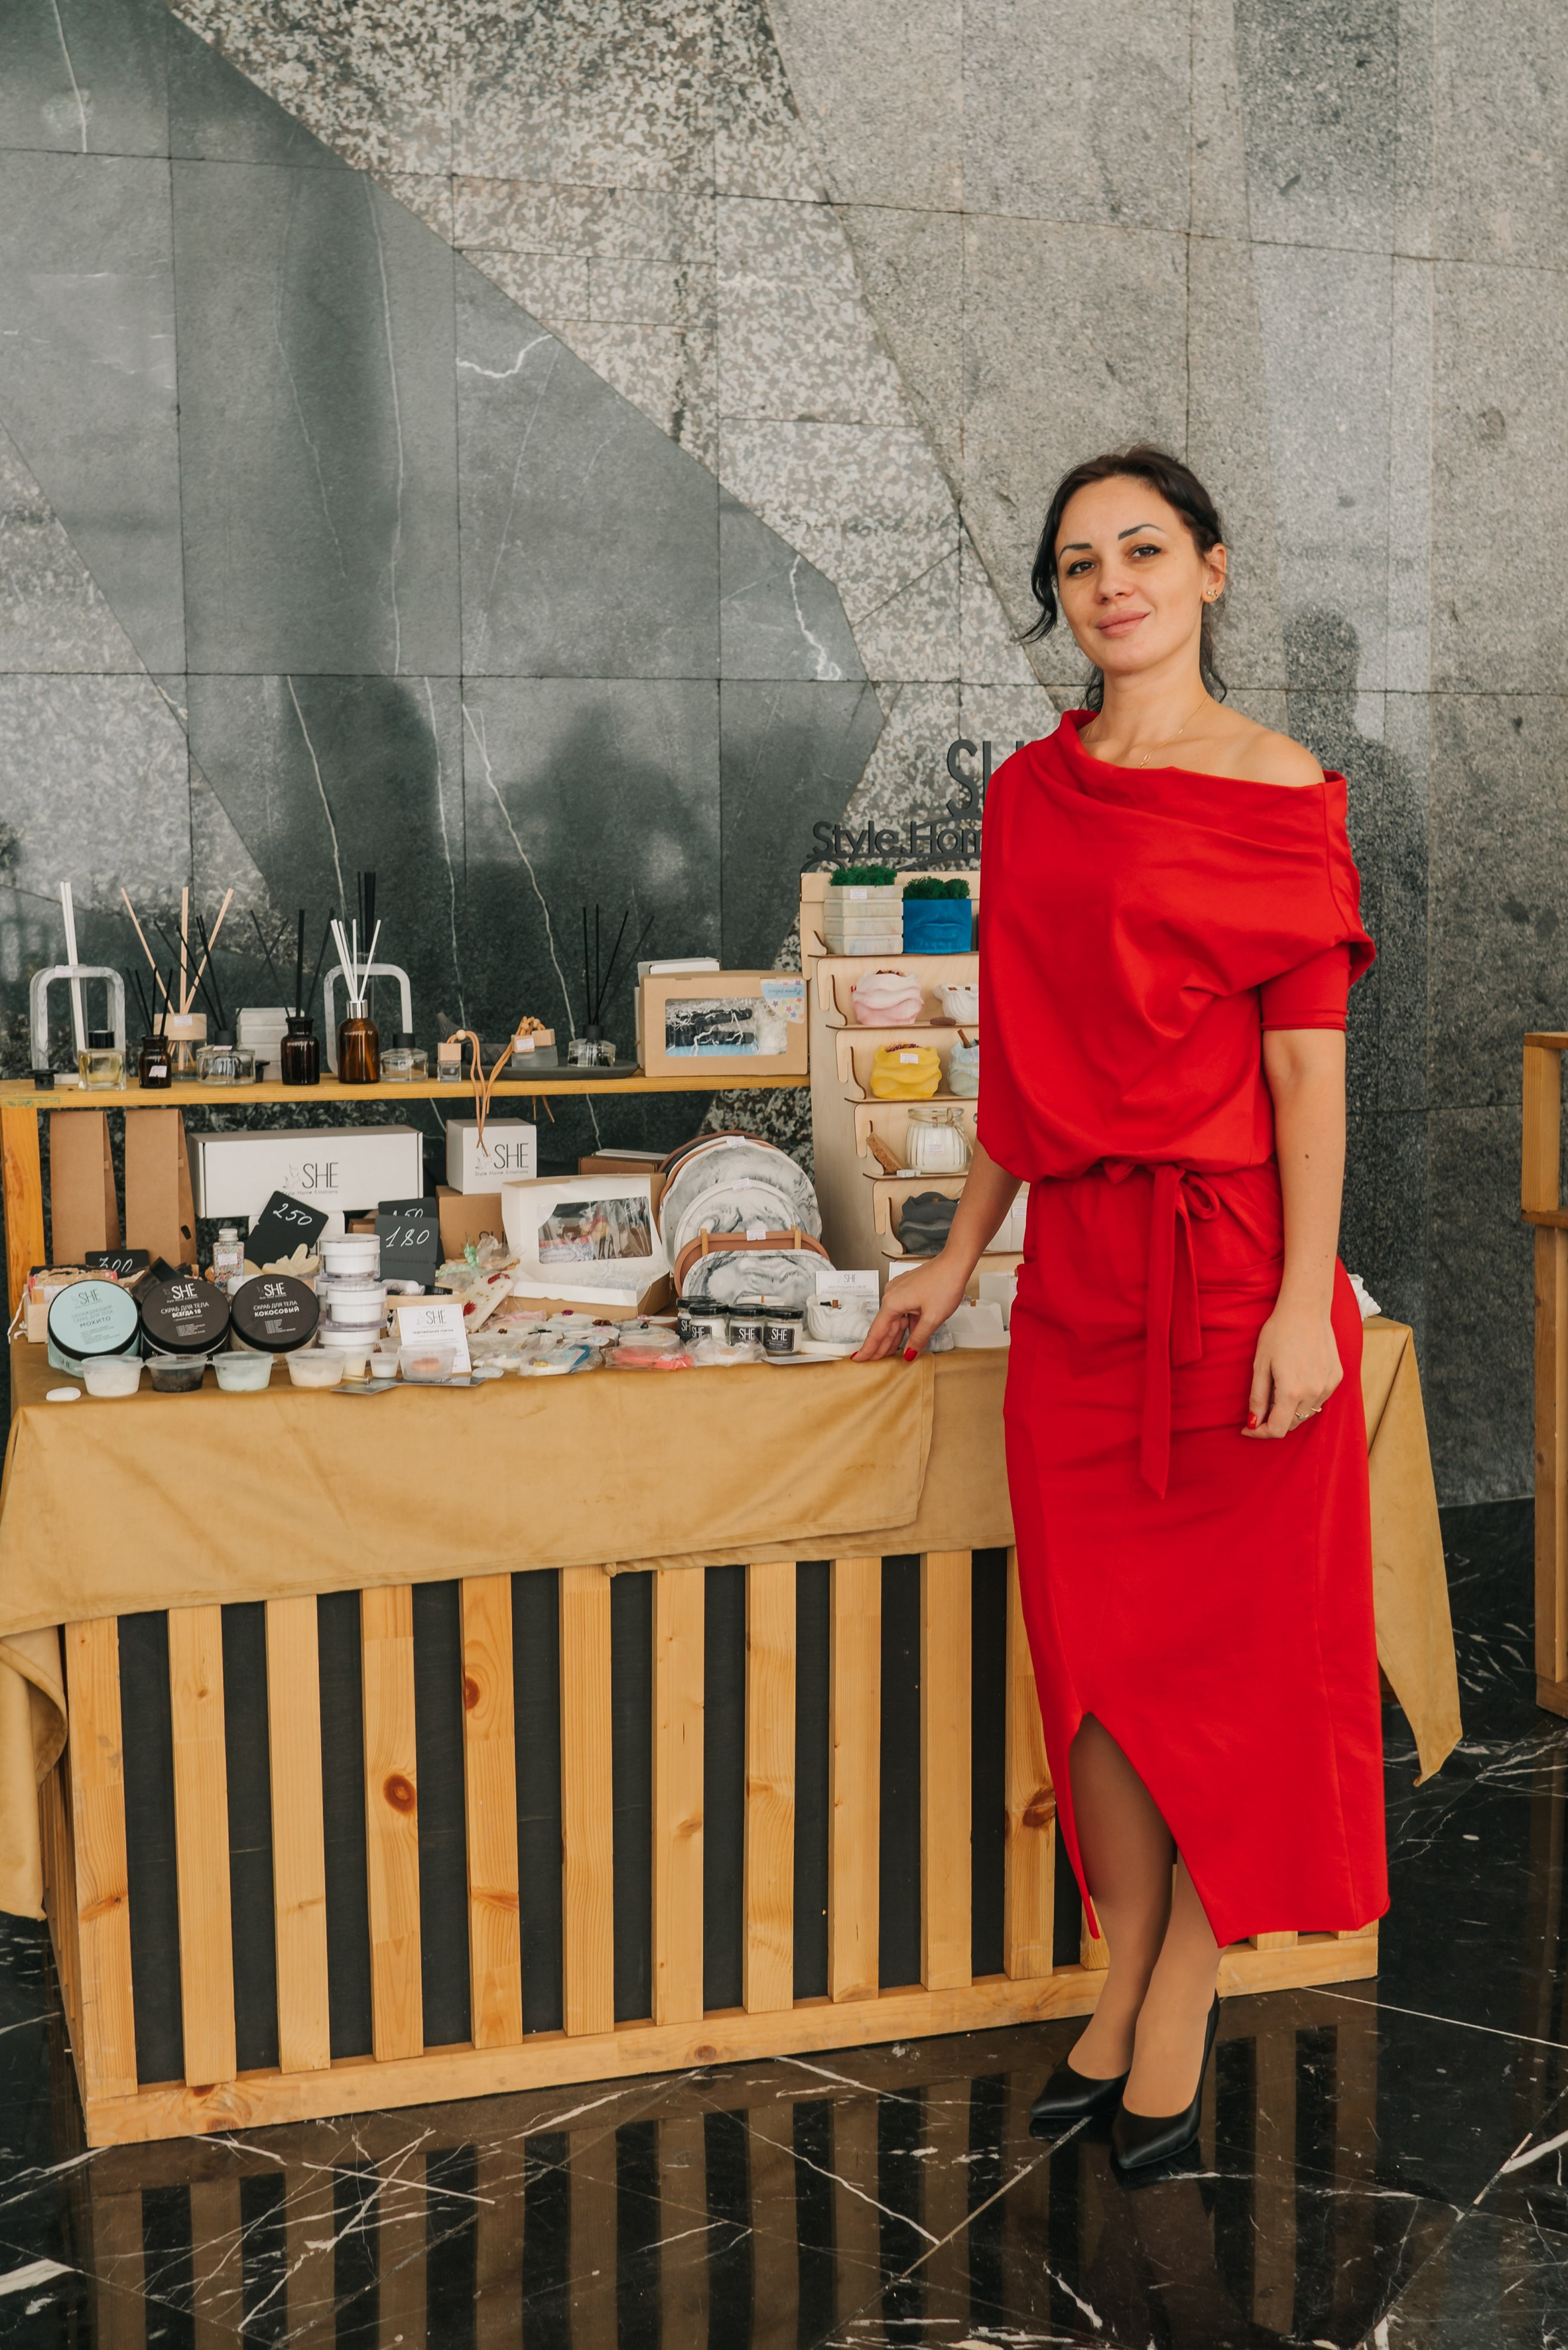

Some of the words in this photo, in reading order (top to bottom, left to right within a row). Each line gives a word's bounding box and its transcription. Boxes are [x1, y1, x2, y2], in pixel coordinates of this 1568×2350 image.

[812, 820, 982, 863] Style.Hom
[493, 1143, 529, 1169] SHE
[302, 1162, 339, 1189] SHE
[273, 1203, 313, 1226] 250
[385, 1226, 430, 1248] 180
[844, 1273, 857, 1283] SHE
[78, 1288, 101, 1305] SHE
[171, 1283, 198, 1300] SHE
[264, 1281, 287, 1297] SHE
[161, 1305, 180, 1315] СКРАБ
[180, 1303, 193, 1312] ДЛЯ
[254, 1306, 300, 1318] КОКОСОВЫЙ
[80, 1316, 111, 1329] МОХИТО
[426, 1310, 447, 1325] SHE
[681, 1319, 690, 1332] SH
[739, 1328, 755, 1340] SHE
[771, 1328, 788, 1341] SHE
